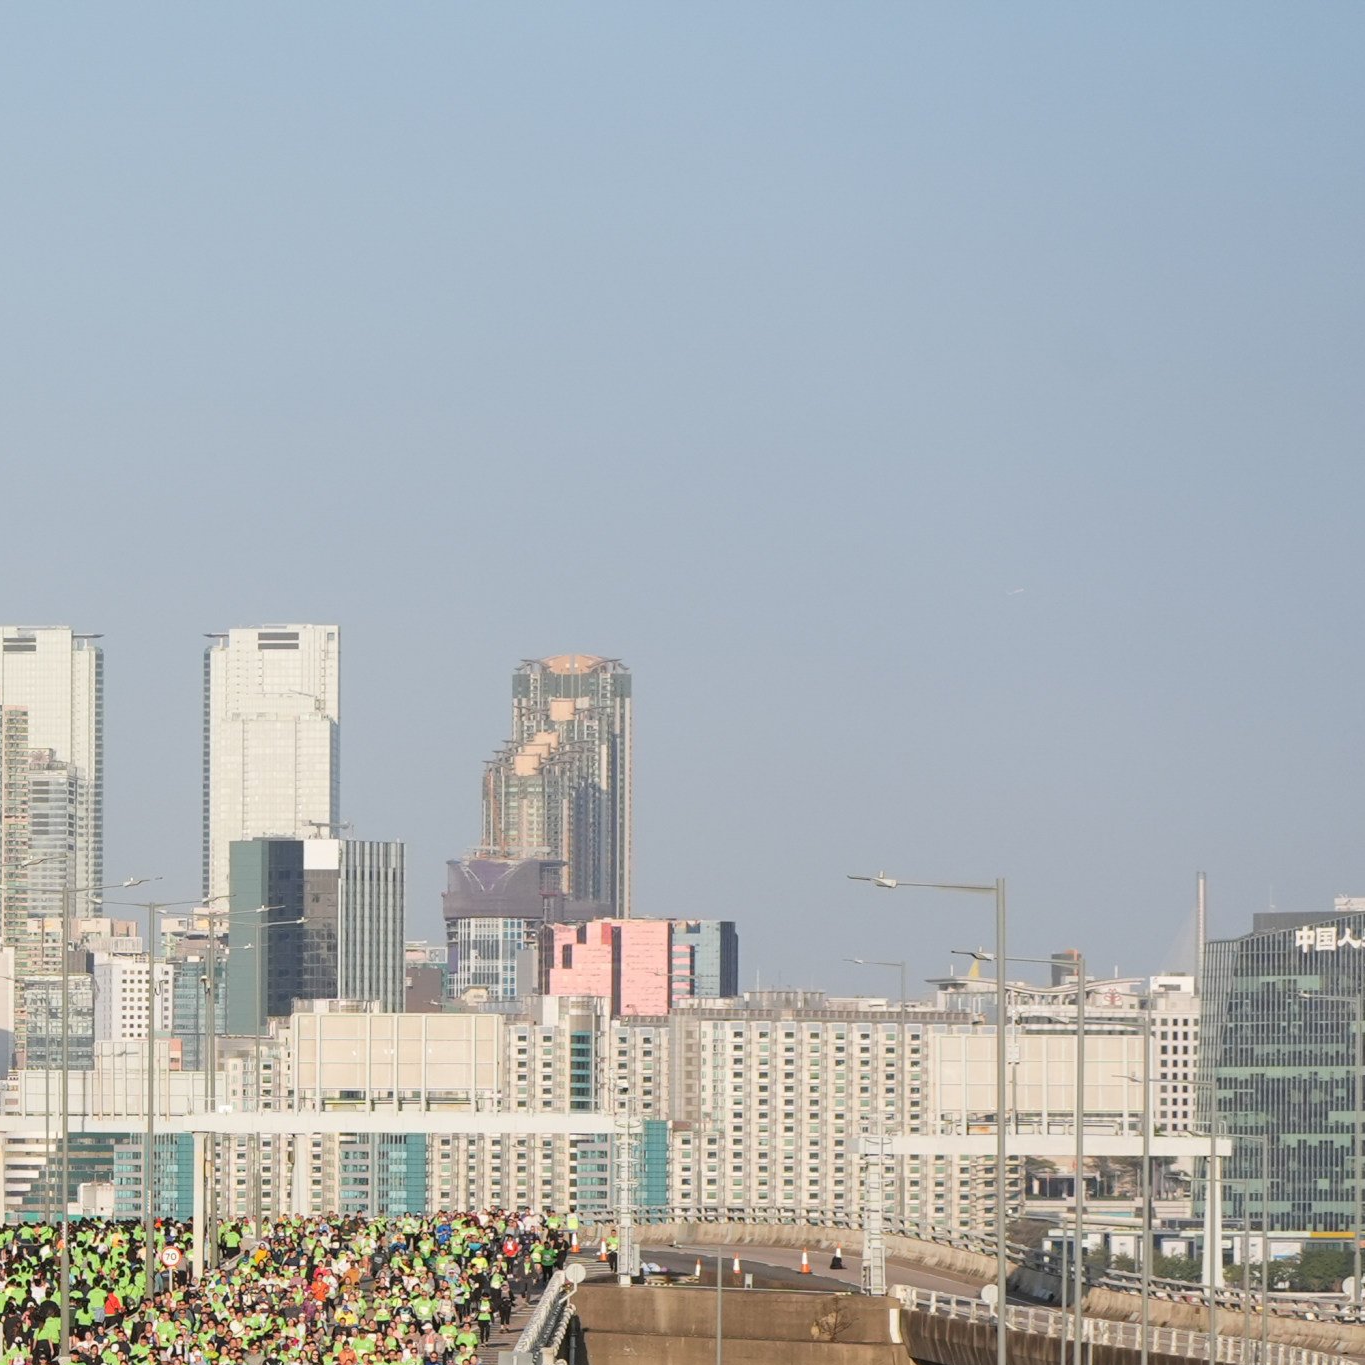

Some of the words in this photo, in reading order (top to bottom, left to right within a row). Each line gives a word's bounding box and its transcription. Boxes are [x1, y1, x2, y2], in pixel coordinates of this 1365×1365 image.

[1295, 925, 1365, 953] 中国人
[165, 1252, 177, 1261] 70
